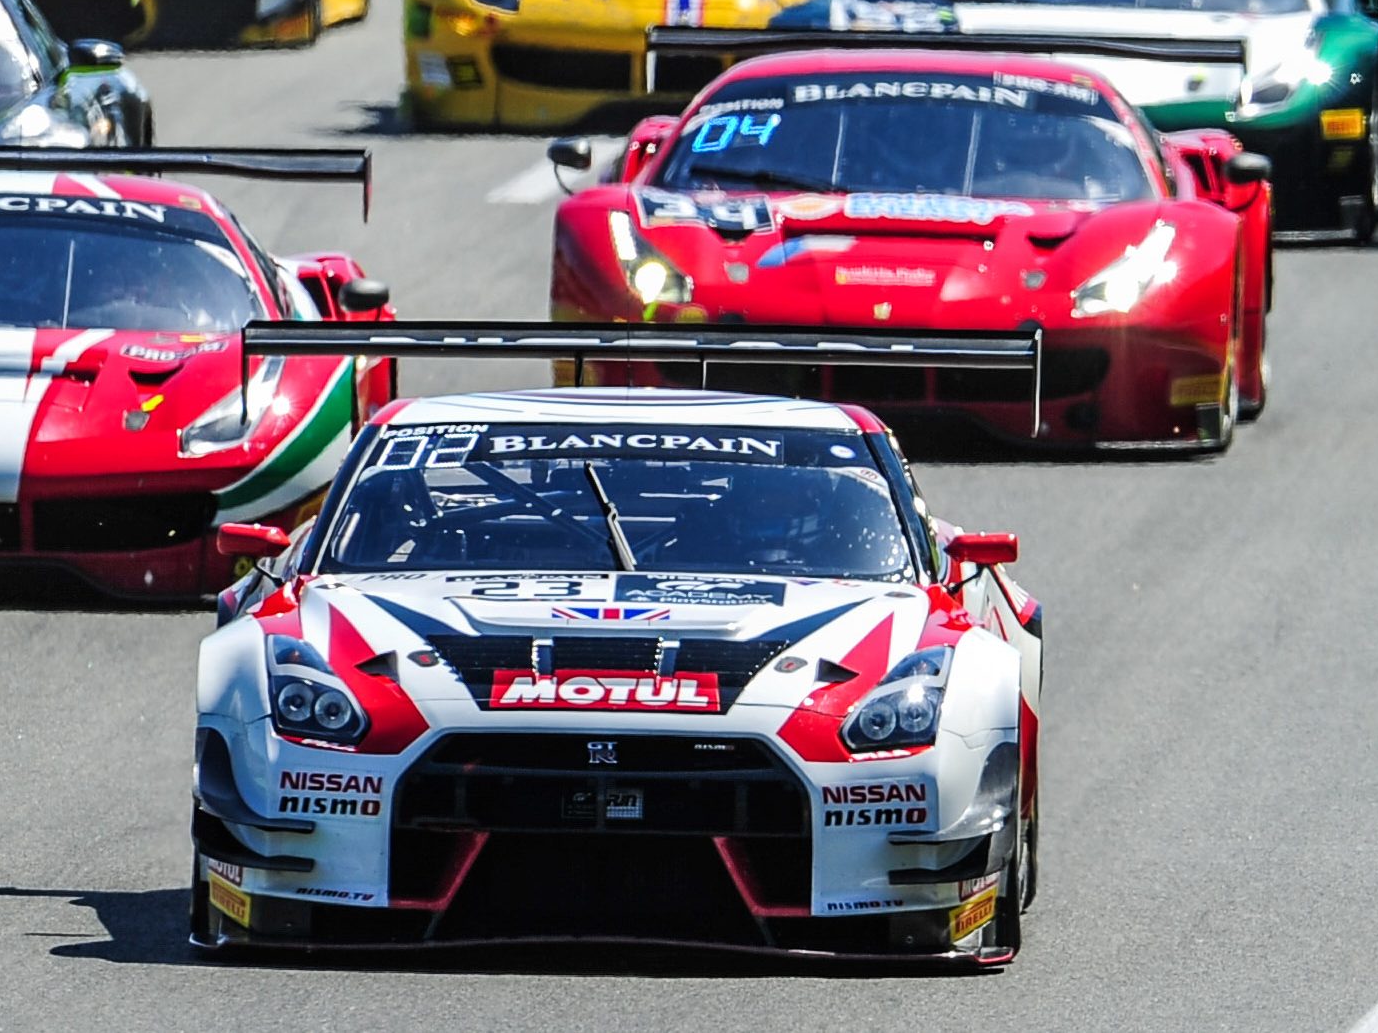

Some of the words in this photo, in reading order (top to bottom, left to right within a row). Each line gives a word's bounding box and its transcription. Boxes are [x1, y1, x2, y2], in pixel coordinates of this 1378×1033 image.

[794, 81, 1028, 108] BLANCPAIN
[691, 113, 782, 154] 04
[382, 423, 490, 440] POSITION
[375, 432, 480, 470] 02
[488, 432, 783, 460] BLANCPAIN
[470, 580, 584, 598] 23
[624, 589, 774, 600] ACADEMY
[497, 675, 712, 708] MOTUL
[279, 771, 383, 795] NISSAN
[823, 783, 927, 805] NISSAN
[278, 794, 382, 817] nismo
[824, 806, 928, 827] nismo
